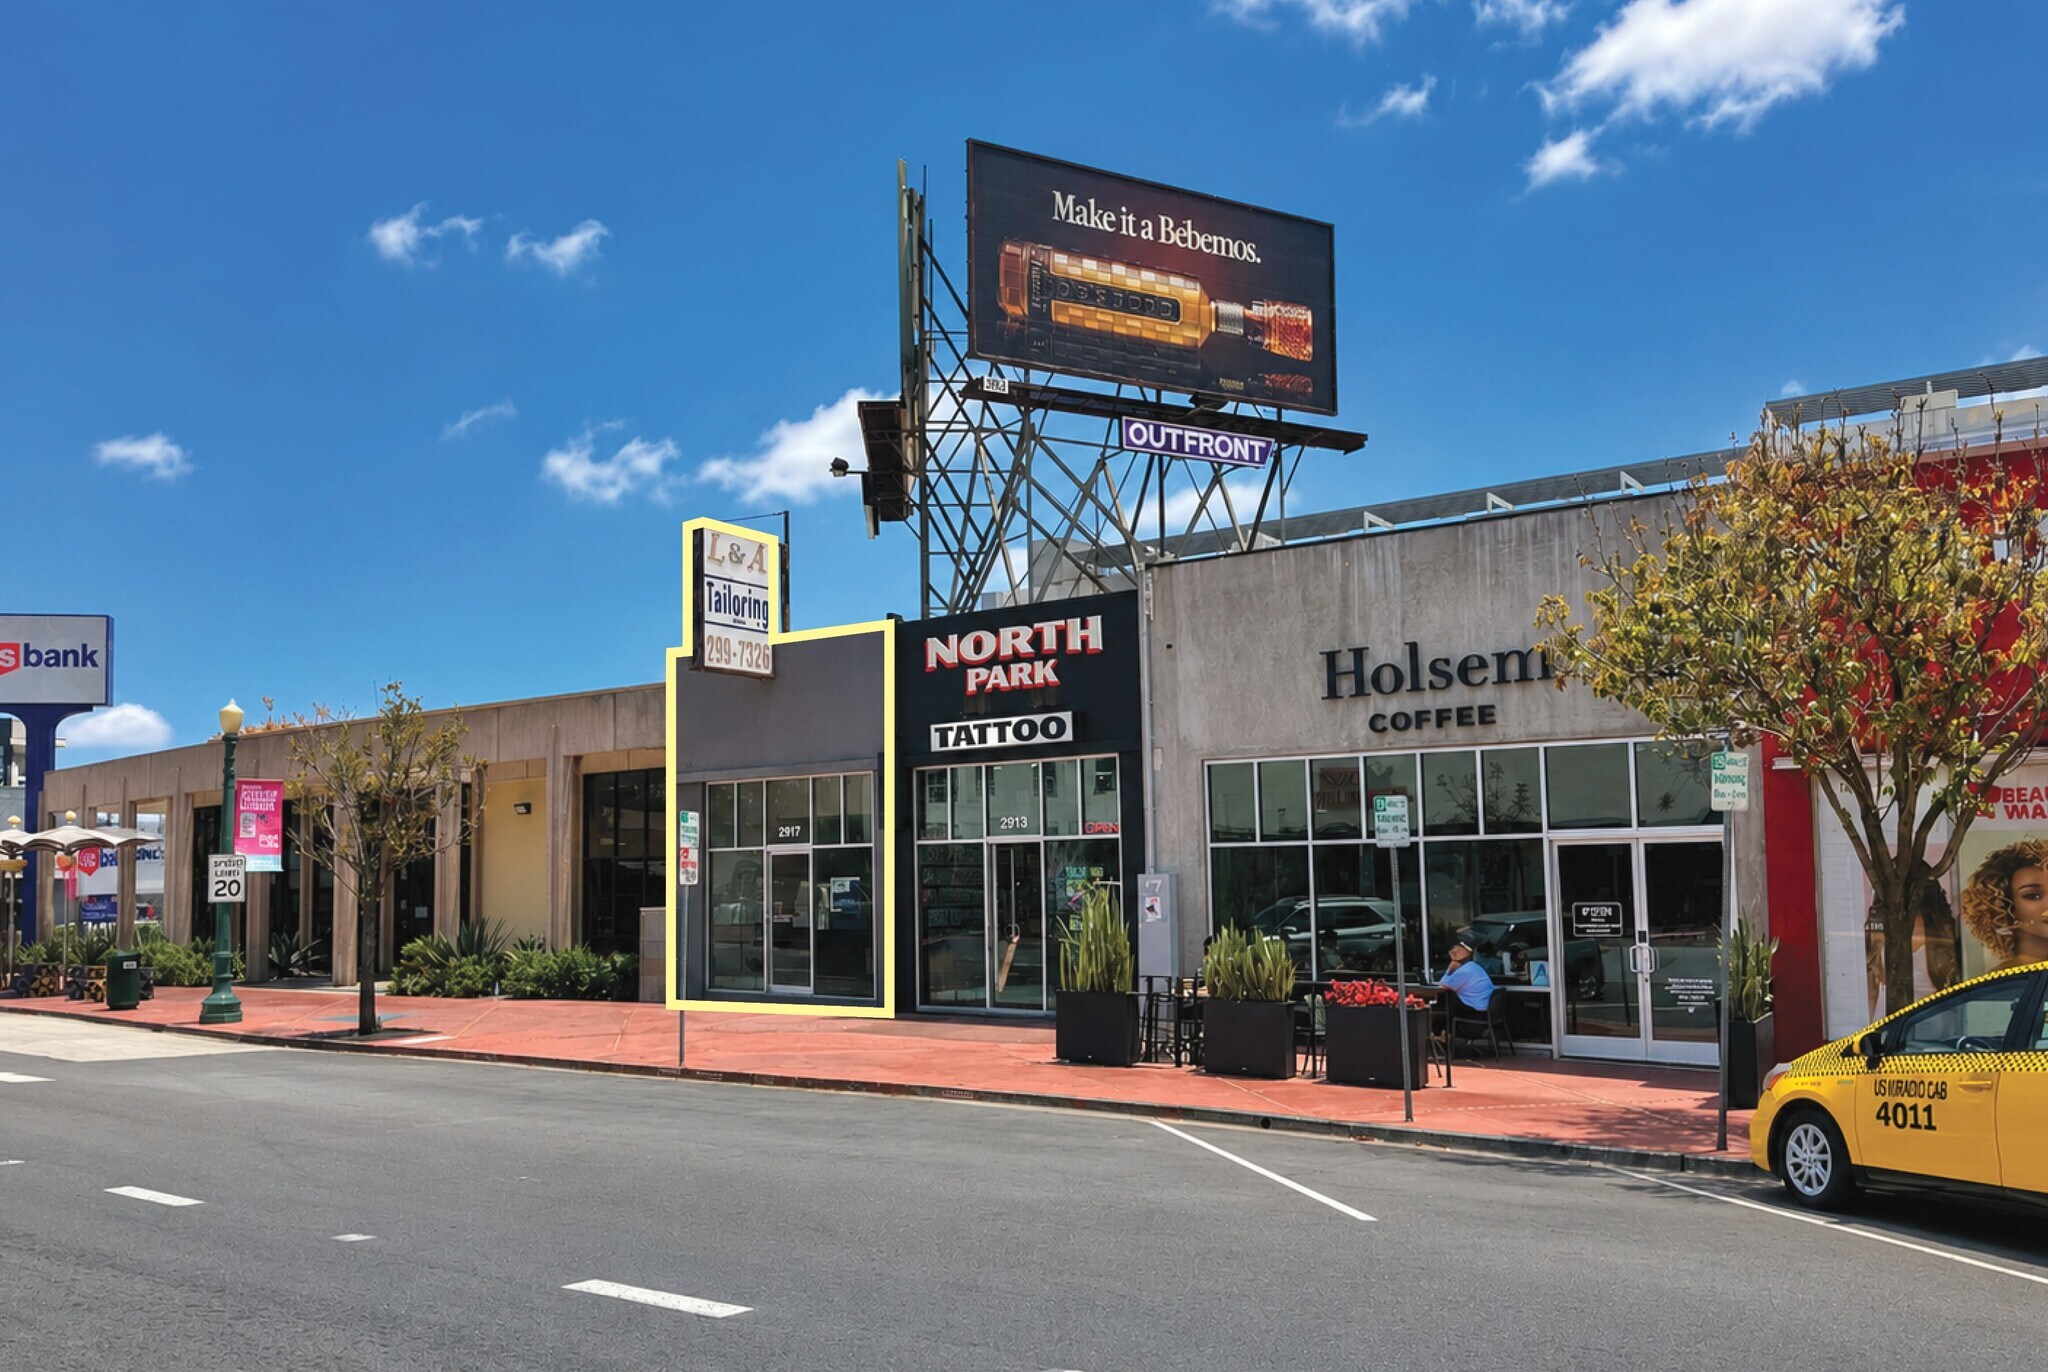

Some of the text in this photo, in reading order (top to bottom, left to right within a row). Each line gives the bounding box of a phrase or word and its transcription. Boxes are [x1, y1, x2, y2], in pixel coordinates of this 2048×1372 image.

[1052, 191, 1116, 232] Make
[1119, 206, 1137, 237] it
[1141, 219, 1154, 240] a
[1128, 422, 1267, 462] OUTFRONT
[707, 533, 767, 574] L & A
[706, 581, 769, 629] Tailoring
[23, 642, 99, 667] bank
[925, 615, 1103, 672] NORTH
[965, 658, 1061, 696] PARK
[1319, 641, 1554, 700] Holsem
[935, 715, 1067, 748] TATTOO
[1368, 705, 1496, 733] COFFEE
[2002, 786, 2048, 803] BEA
[778, 826, 801, 838] 2917
[1000, 816, 1028, 830] 2913
[214, 879, 241, 897] 20
[1927, 1081, 1947, 1100] CAB
[1876, 1101, 1937, 1131] 4011
